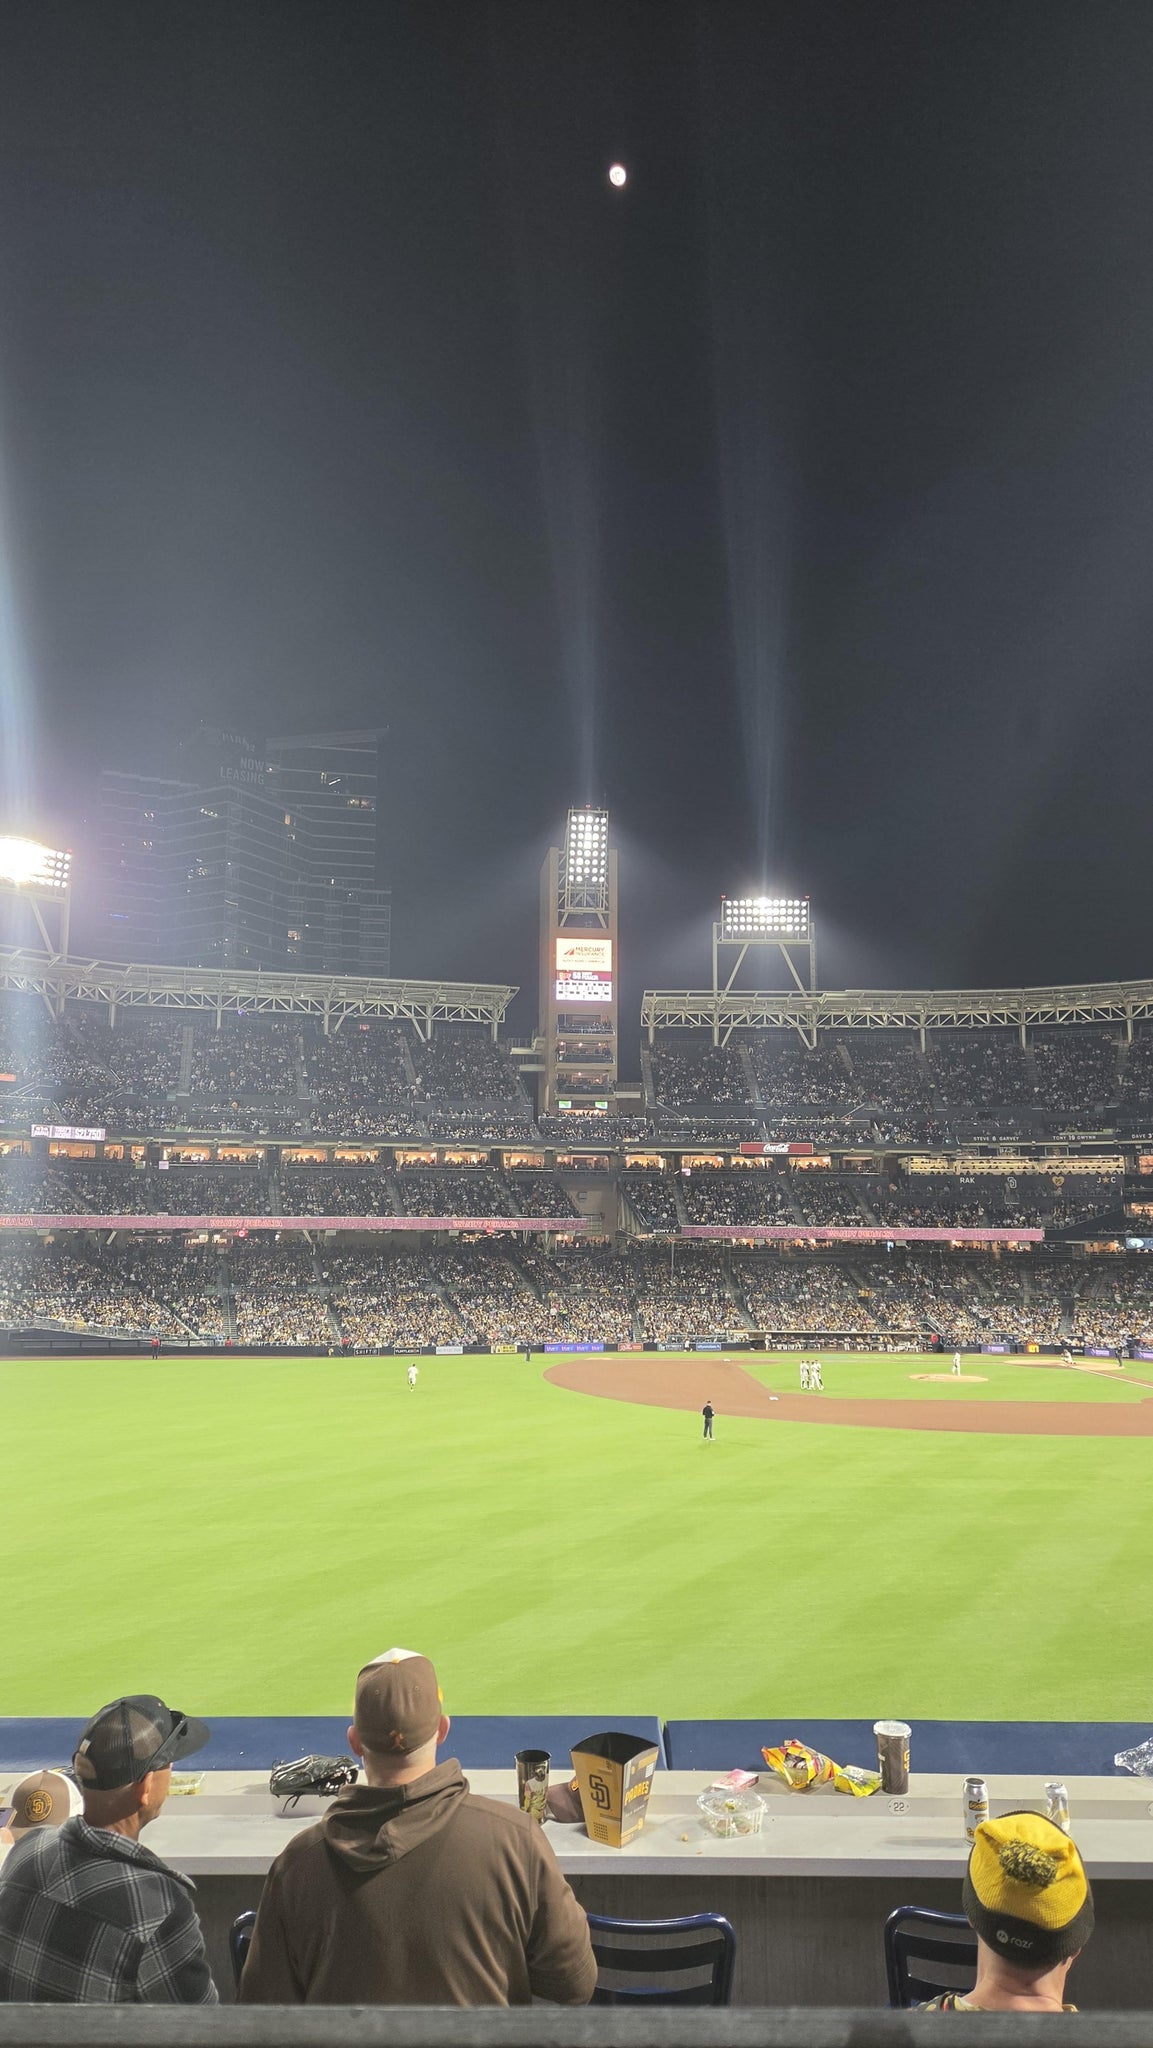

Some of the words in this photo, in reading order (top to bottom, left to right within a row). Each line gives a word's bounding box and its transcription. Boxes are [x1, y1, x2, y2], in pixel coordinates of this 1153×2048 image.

[240, 757, 264, 772] NOW
[220, 766, 264, 785] LEASING
[763, 1144, 790, 1152] Coca-Cola
[589, 1773, 611, 1810] SD
[625, 1780, 650, 1806] PADRES
[33, 1798, 45, 1814] SD
[894, 1802, 905, 1812] 22
[1010, 1937, 1034, 1949] razr
